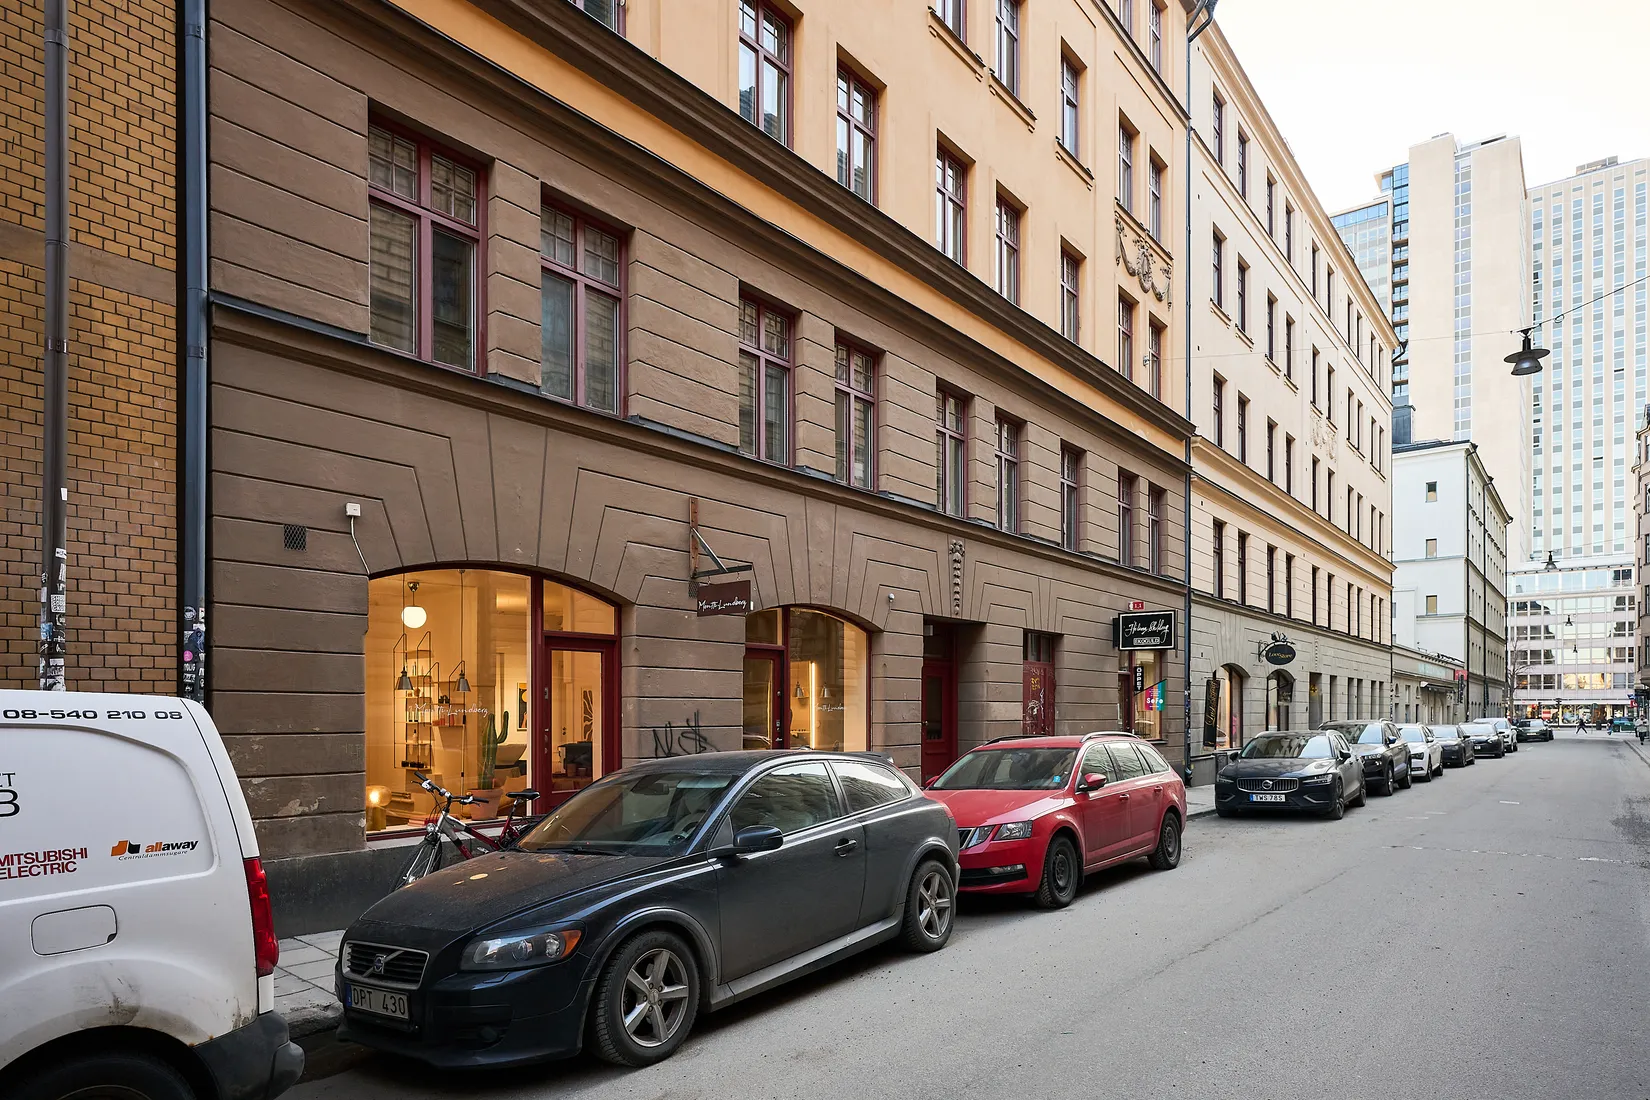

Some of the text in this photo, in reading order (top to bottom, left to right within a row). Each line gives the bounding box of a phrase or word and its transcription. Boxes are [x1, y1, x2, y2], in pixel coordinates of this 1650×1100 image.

[2, 709, 183, 720] 08-540 210 08
[0, 772, 16, 788] T
[145, 840, 199, 853] allaway
[0, 847, 88, 867] MITSUBISHI
[0, 861, 77, 880] ELECTRIC
[382, 993, 406, 1015] 430
